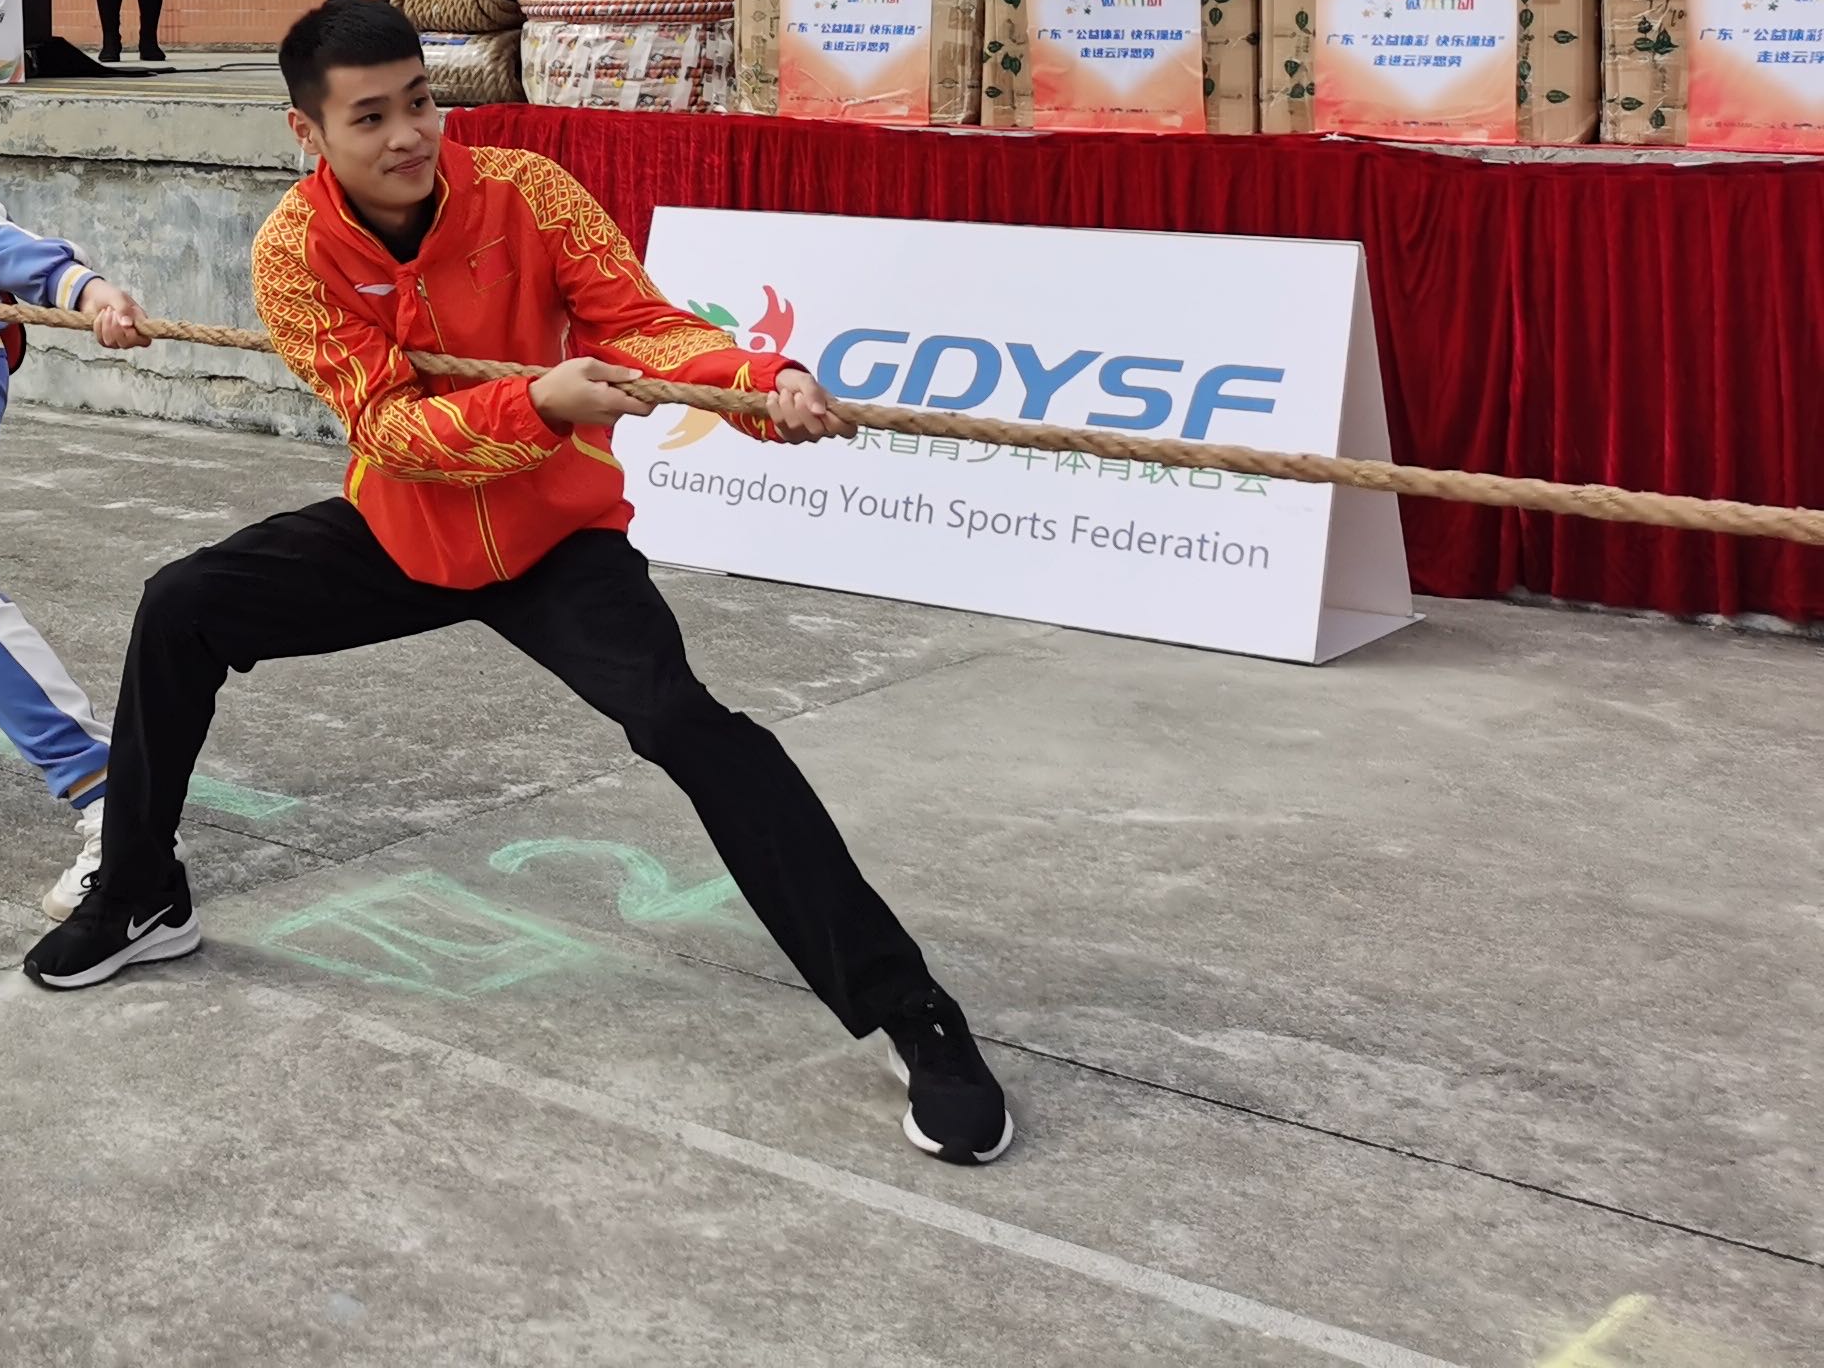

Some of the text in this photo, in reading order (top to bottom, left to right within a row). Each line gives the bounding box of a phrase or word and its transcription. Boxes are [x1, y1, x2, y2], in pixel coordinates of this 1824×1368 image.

[817, 327, 1286, 441] GDYSF
[648, 460, 1271, 570] Guangdong Youth Sports Federation
